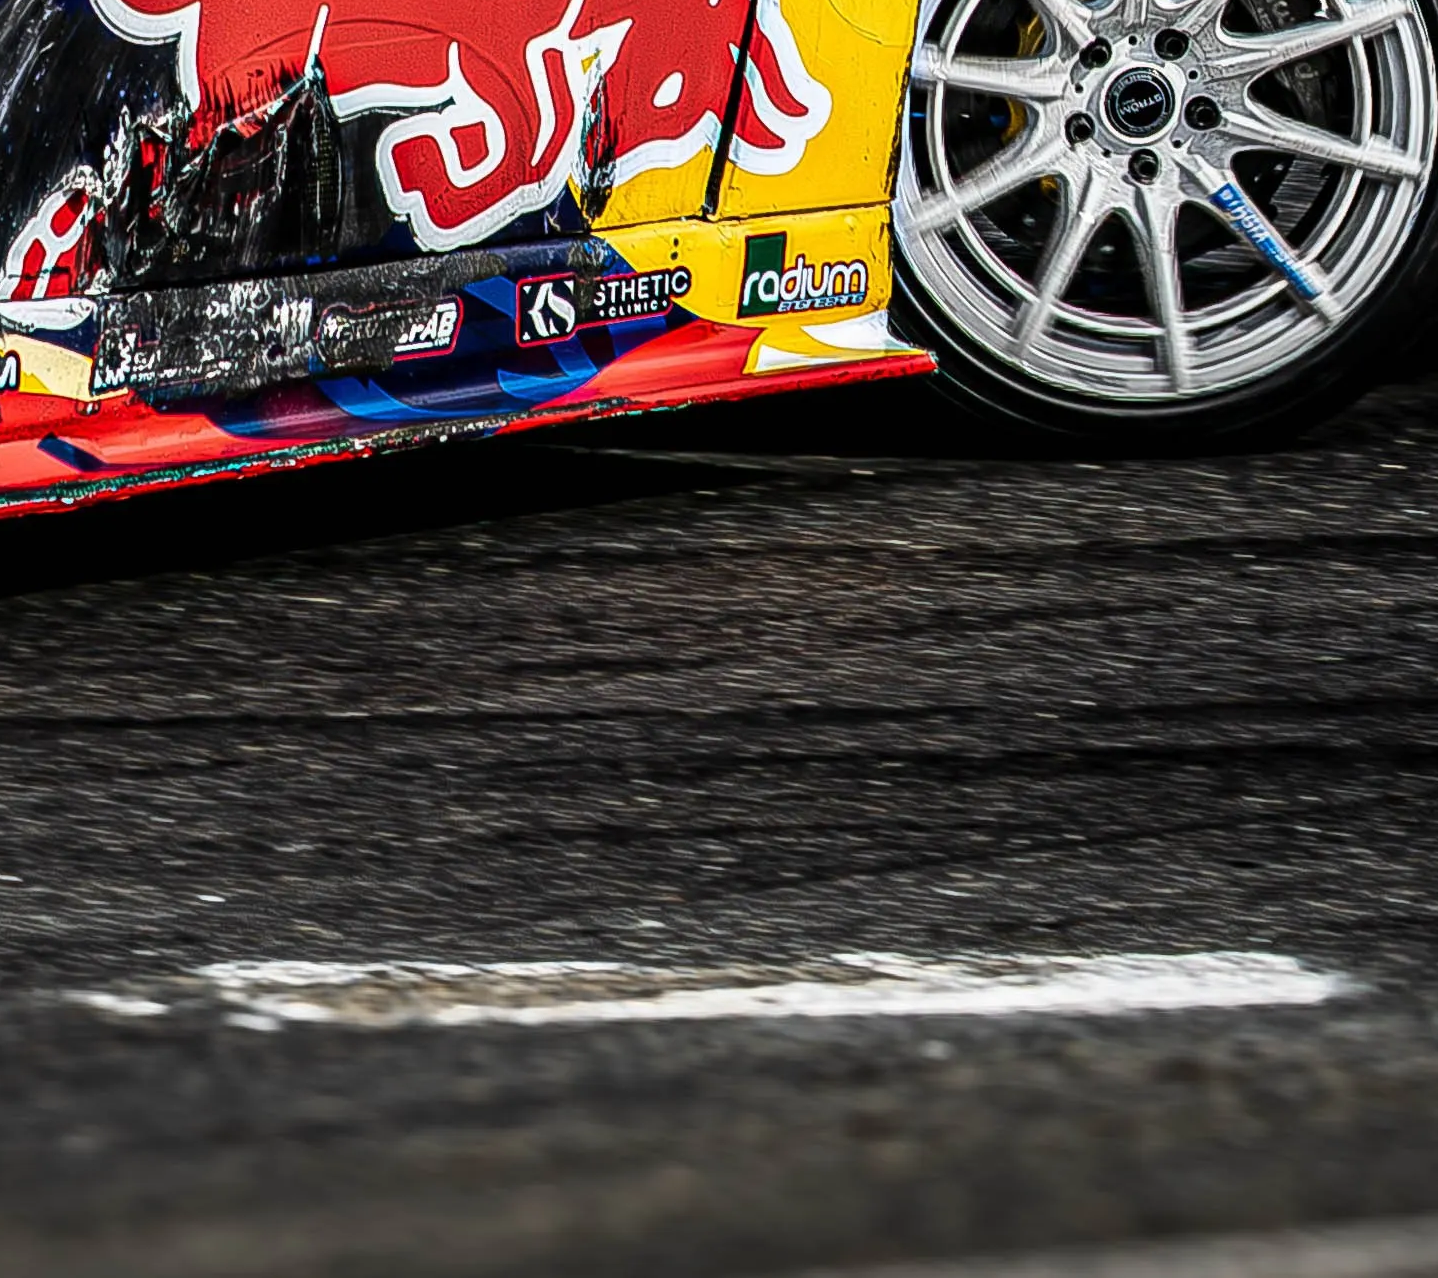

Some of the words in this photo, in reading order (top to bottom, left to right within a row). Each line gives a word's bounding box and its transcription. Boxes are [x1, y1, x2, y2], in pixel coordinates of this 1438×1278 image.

[591, 270, 692, 307] STHETIC
[742, 256, 868, 307] radium
[607, 299, 658, 319] CLINIC
